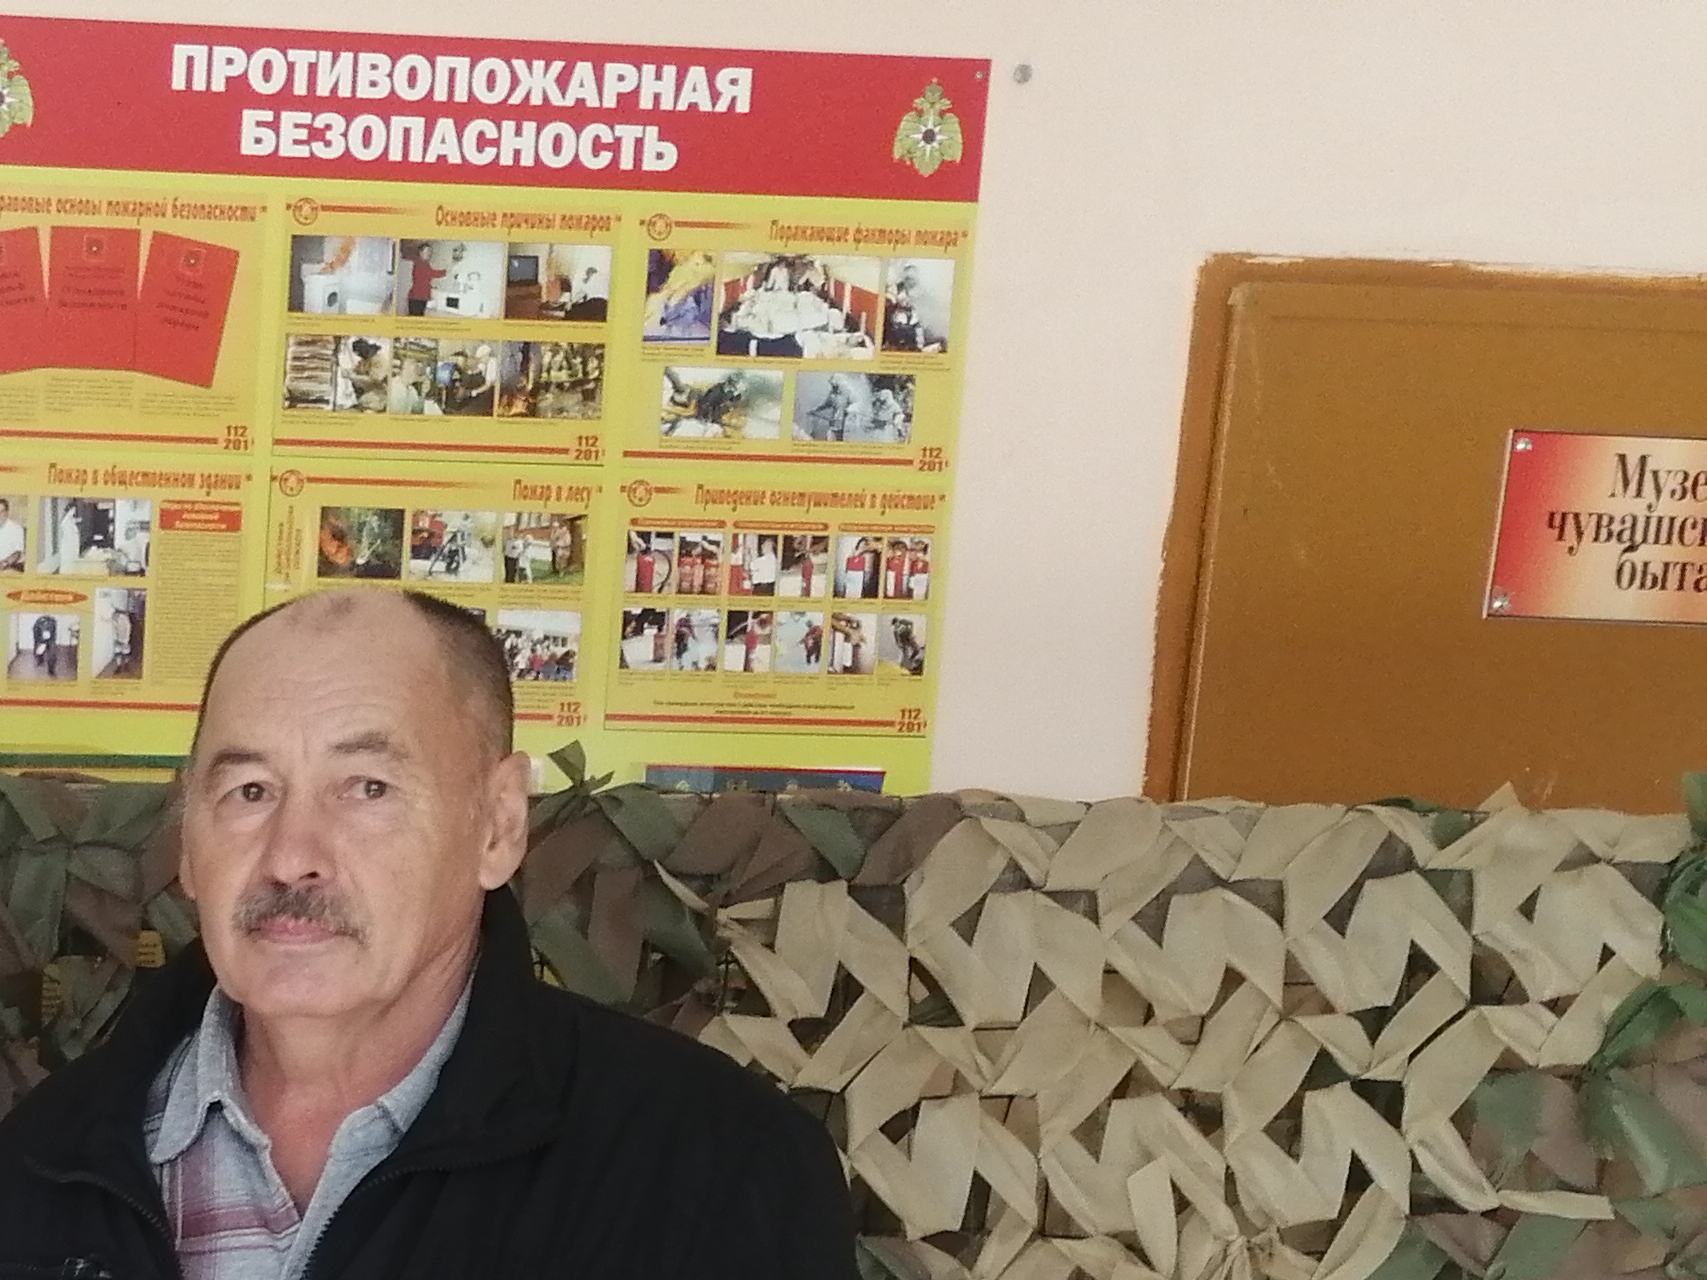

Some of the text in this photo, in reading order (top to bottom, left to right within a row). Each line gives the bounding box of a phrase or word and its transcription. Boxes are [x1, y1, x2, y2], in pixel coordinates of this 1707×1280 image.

[171, 43, 753, 113] ПРОТИВОПОЖАРНАЯ
[239, 109, 679, 173] БЕЗОПАСНОСТЬ
[56, 197, 102, 216] основы
[105, 197, 167, 226] пожарной
[171, 196, 257, 223] безопасности
[436, 205, 612, 239] Основные причины пожаров
[769, 219, 959, 252] Поражающие факторы пожара
[226, 425, 248, 437] 112
[576, 435, 599, 448] 112
[921, 447, 942, 459] 112
[47, 462, 243, 497] Пожар в общественном здании
[513, 478, 593, 509] Пожар в лесу
[694, 484, 935, 516] Приведение огнетушителей в действие
[1615, 541, 1707, 593] быта
[559, 701, 581, 713] 112
[900, 708, 921, 720] 112
